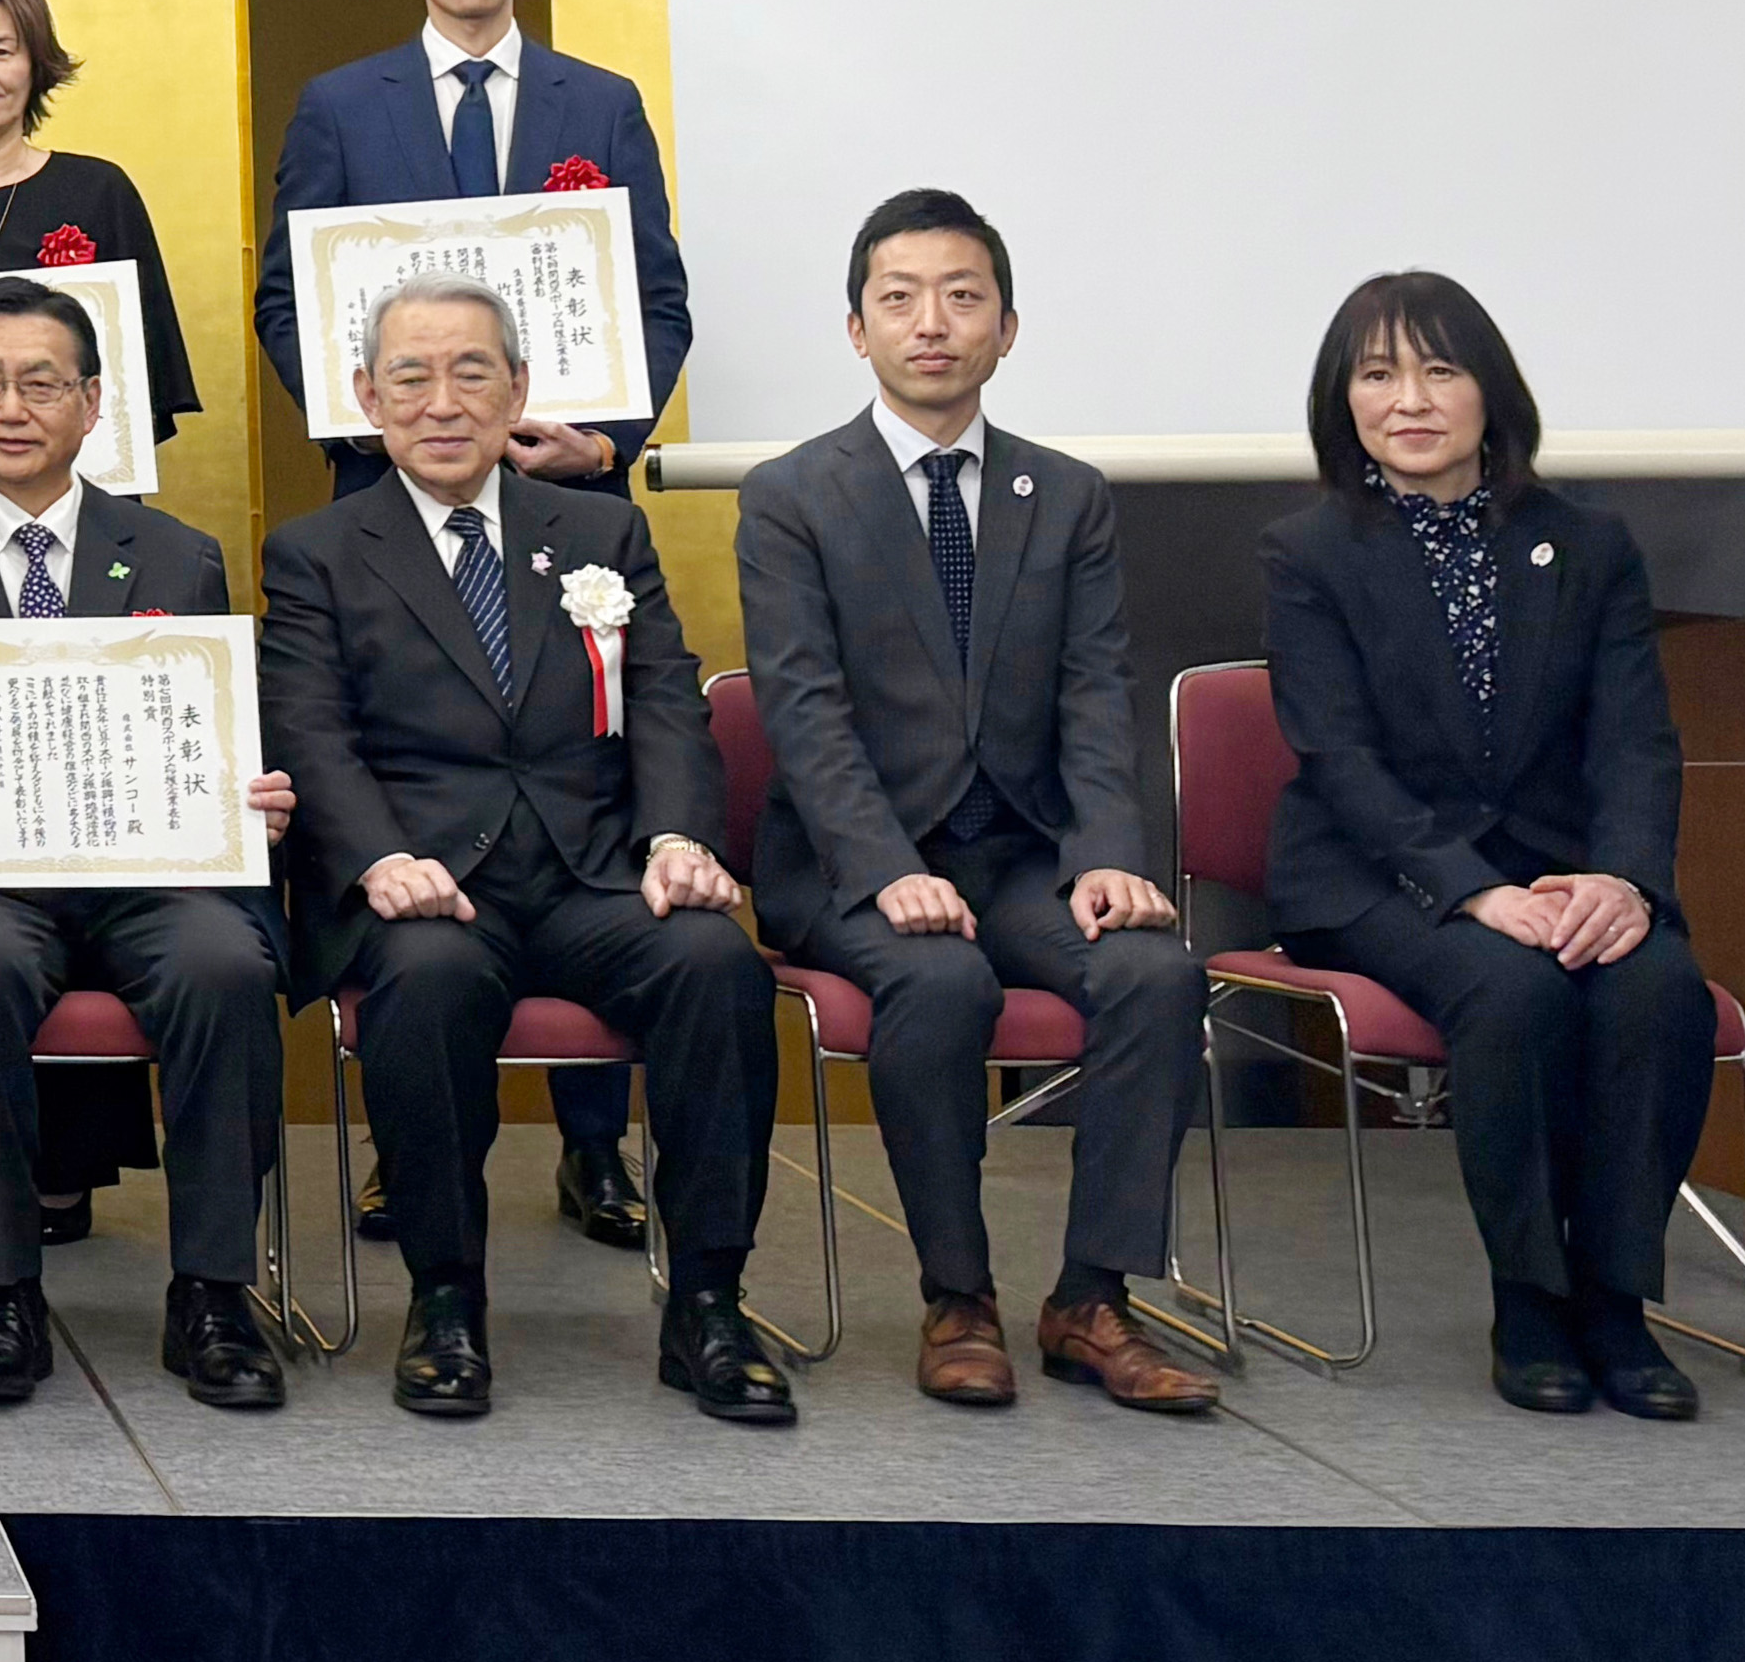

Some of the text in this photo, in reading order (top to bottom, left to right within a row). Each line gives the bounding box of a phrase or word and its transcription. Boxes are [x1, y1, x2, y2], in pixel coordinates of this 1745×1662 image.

[566, 268, 593, 346] 表彰状
[141, 675, 157, 721] 特別賞
[179, 704, 209, 796] 表彰状
